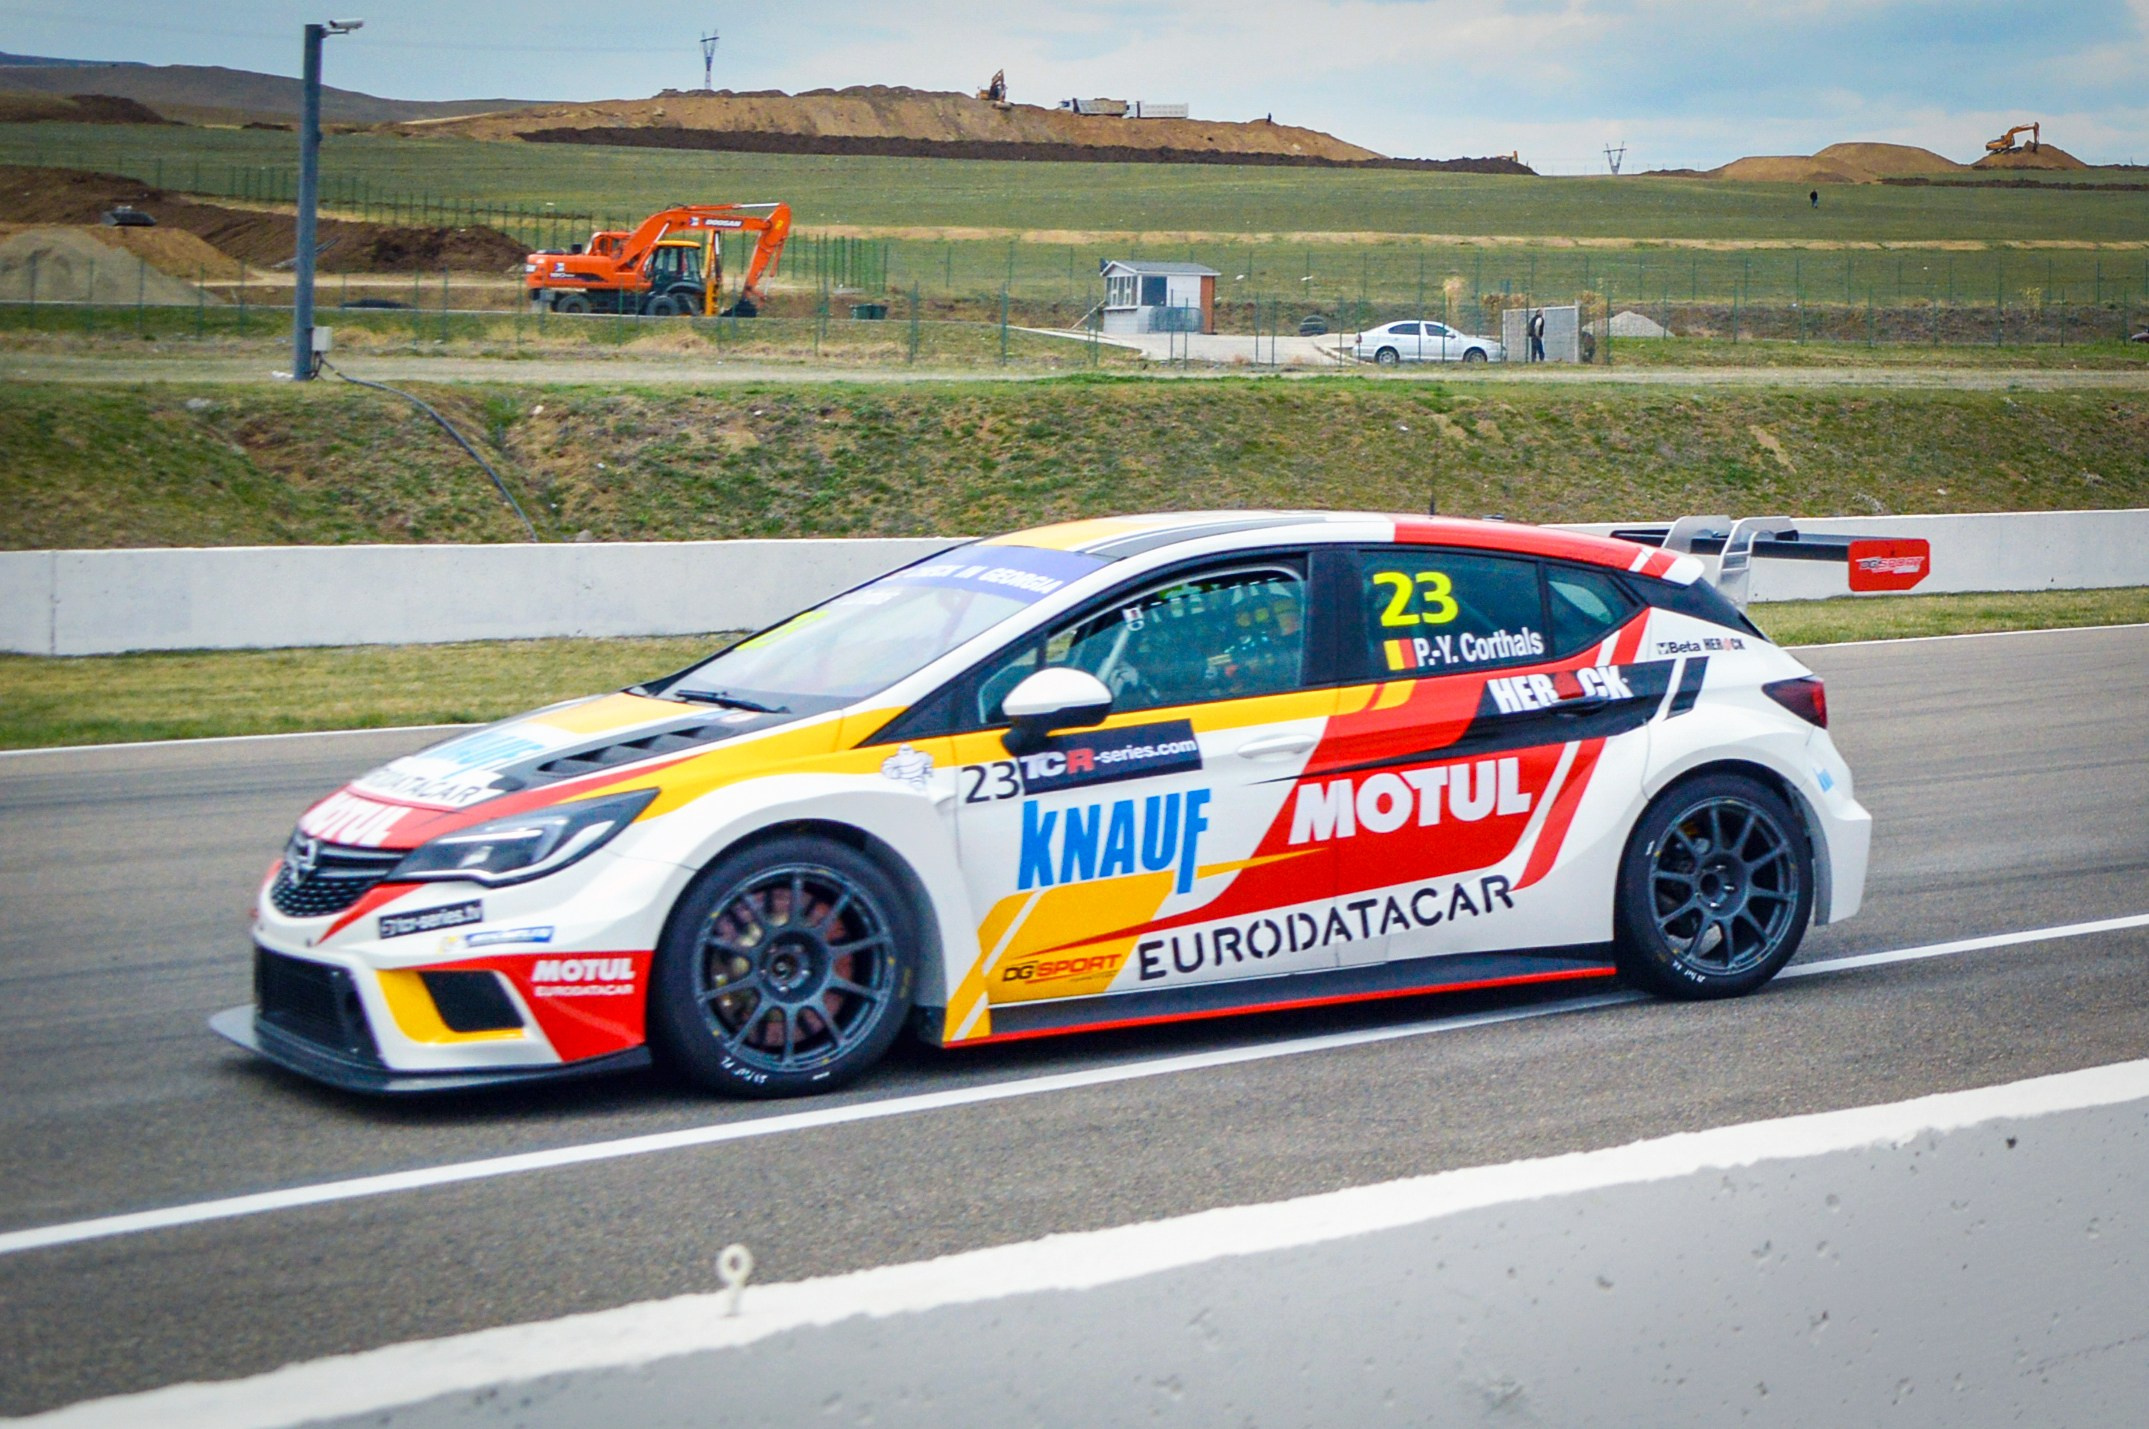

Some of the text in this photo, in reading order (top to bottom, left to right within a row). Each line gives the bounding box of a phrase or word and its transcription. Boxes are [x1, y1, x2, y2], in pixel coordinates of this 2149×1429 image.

[978, 568, 1063, 594] GEORGIA
[1373, 571, 1459, 627] 23
[1413, 626, 1544, 667] P.-Y. Corthals
[1669, 641, 1701, 653] Beta
[1020, 739, 1197, 780] TCR-series.com
[961, 761, 1019, 803] 23
[1288, 757, 1532, 845] MOTUL
[1018, 788, 1210, 893] KNAUF
[1138, 874, 1514, 981] EURODATACAR
[531, 958, 635, 982] MOTUL
[1002, 965, 1035, 982] DG
[1036, 953, 1122, 977] SPORT
